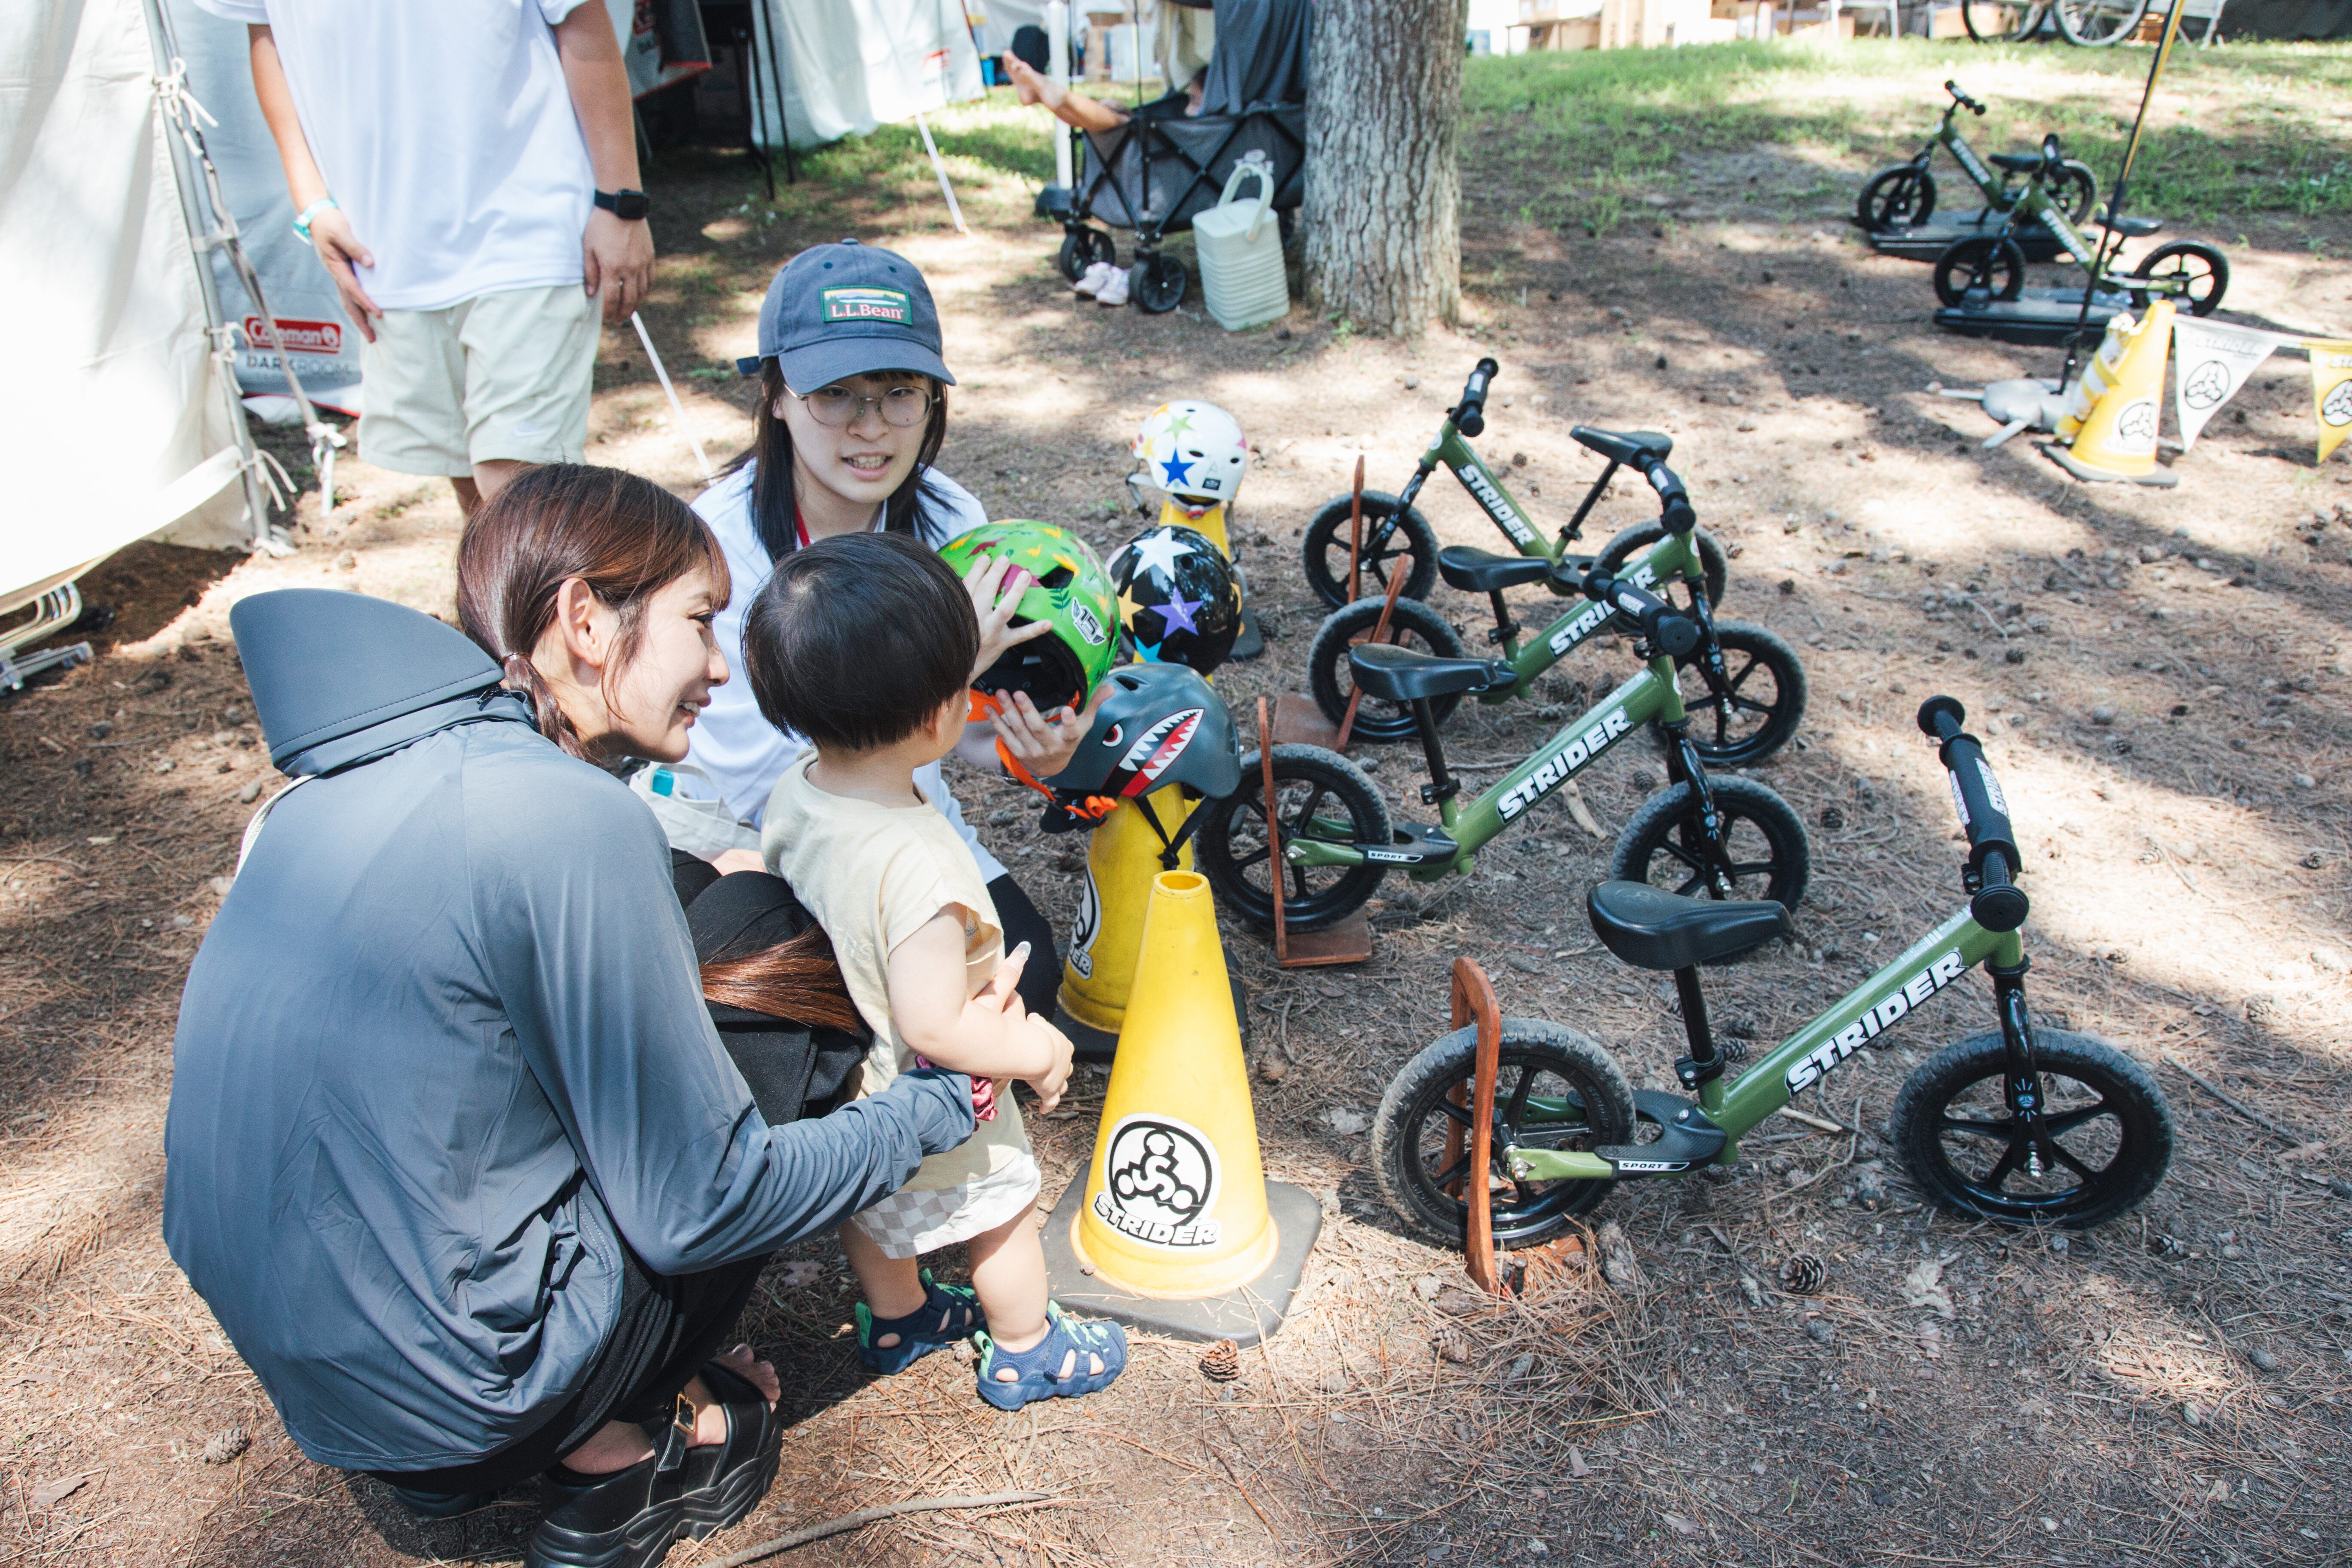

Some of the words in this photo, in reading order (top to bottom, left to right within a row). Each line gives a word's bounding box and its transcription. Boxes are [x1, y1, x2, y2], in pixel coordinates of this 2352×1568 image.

[831, 303, 902, 320] L.L.Bean
[1458, 463, 1535, 546] STRIDER
[1498, 709, 1632, 821] STRIDER
[1786, 951, 1969, 1094] STRIDER
[1094, 1194, 1217, 1246] STRIDER
